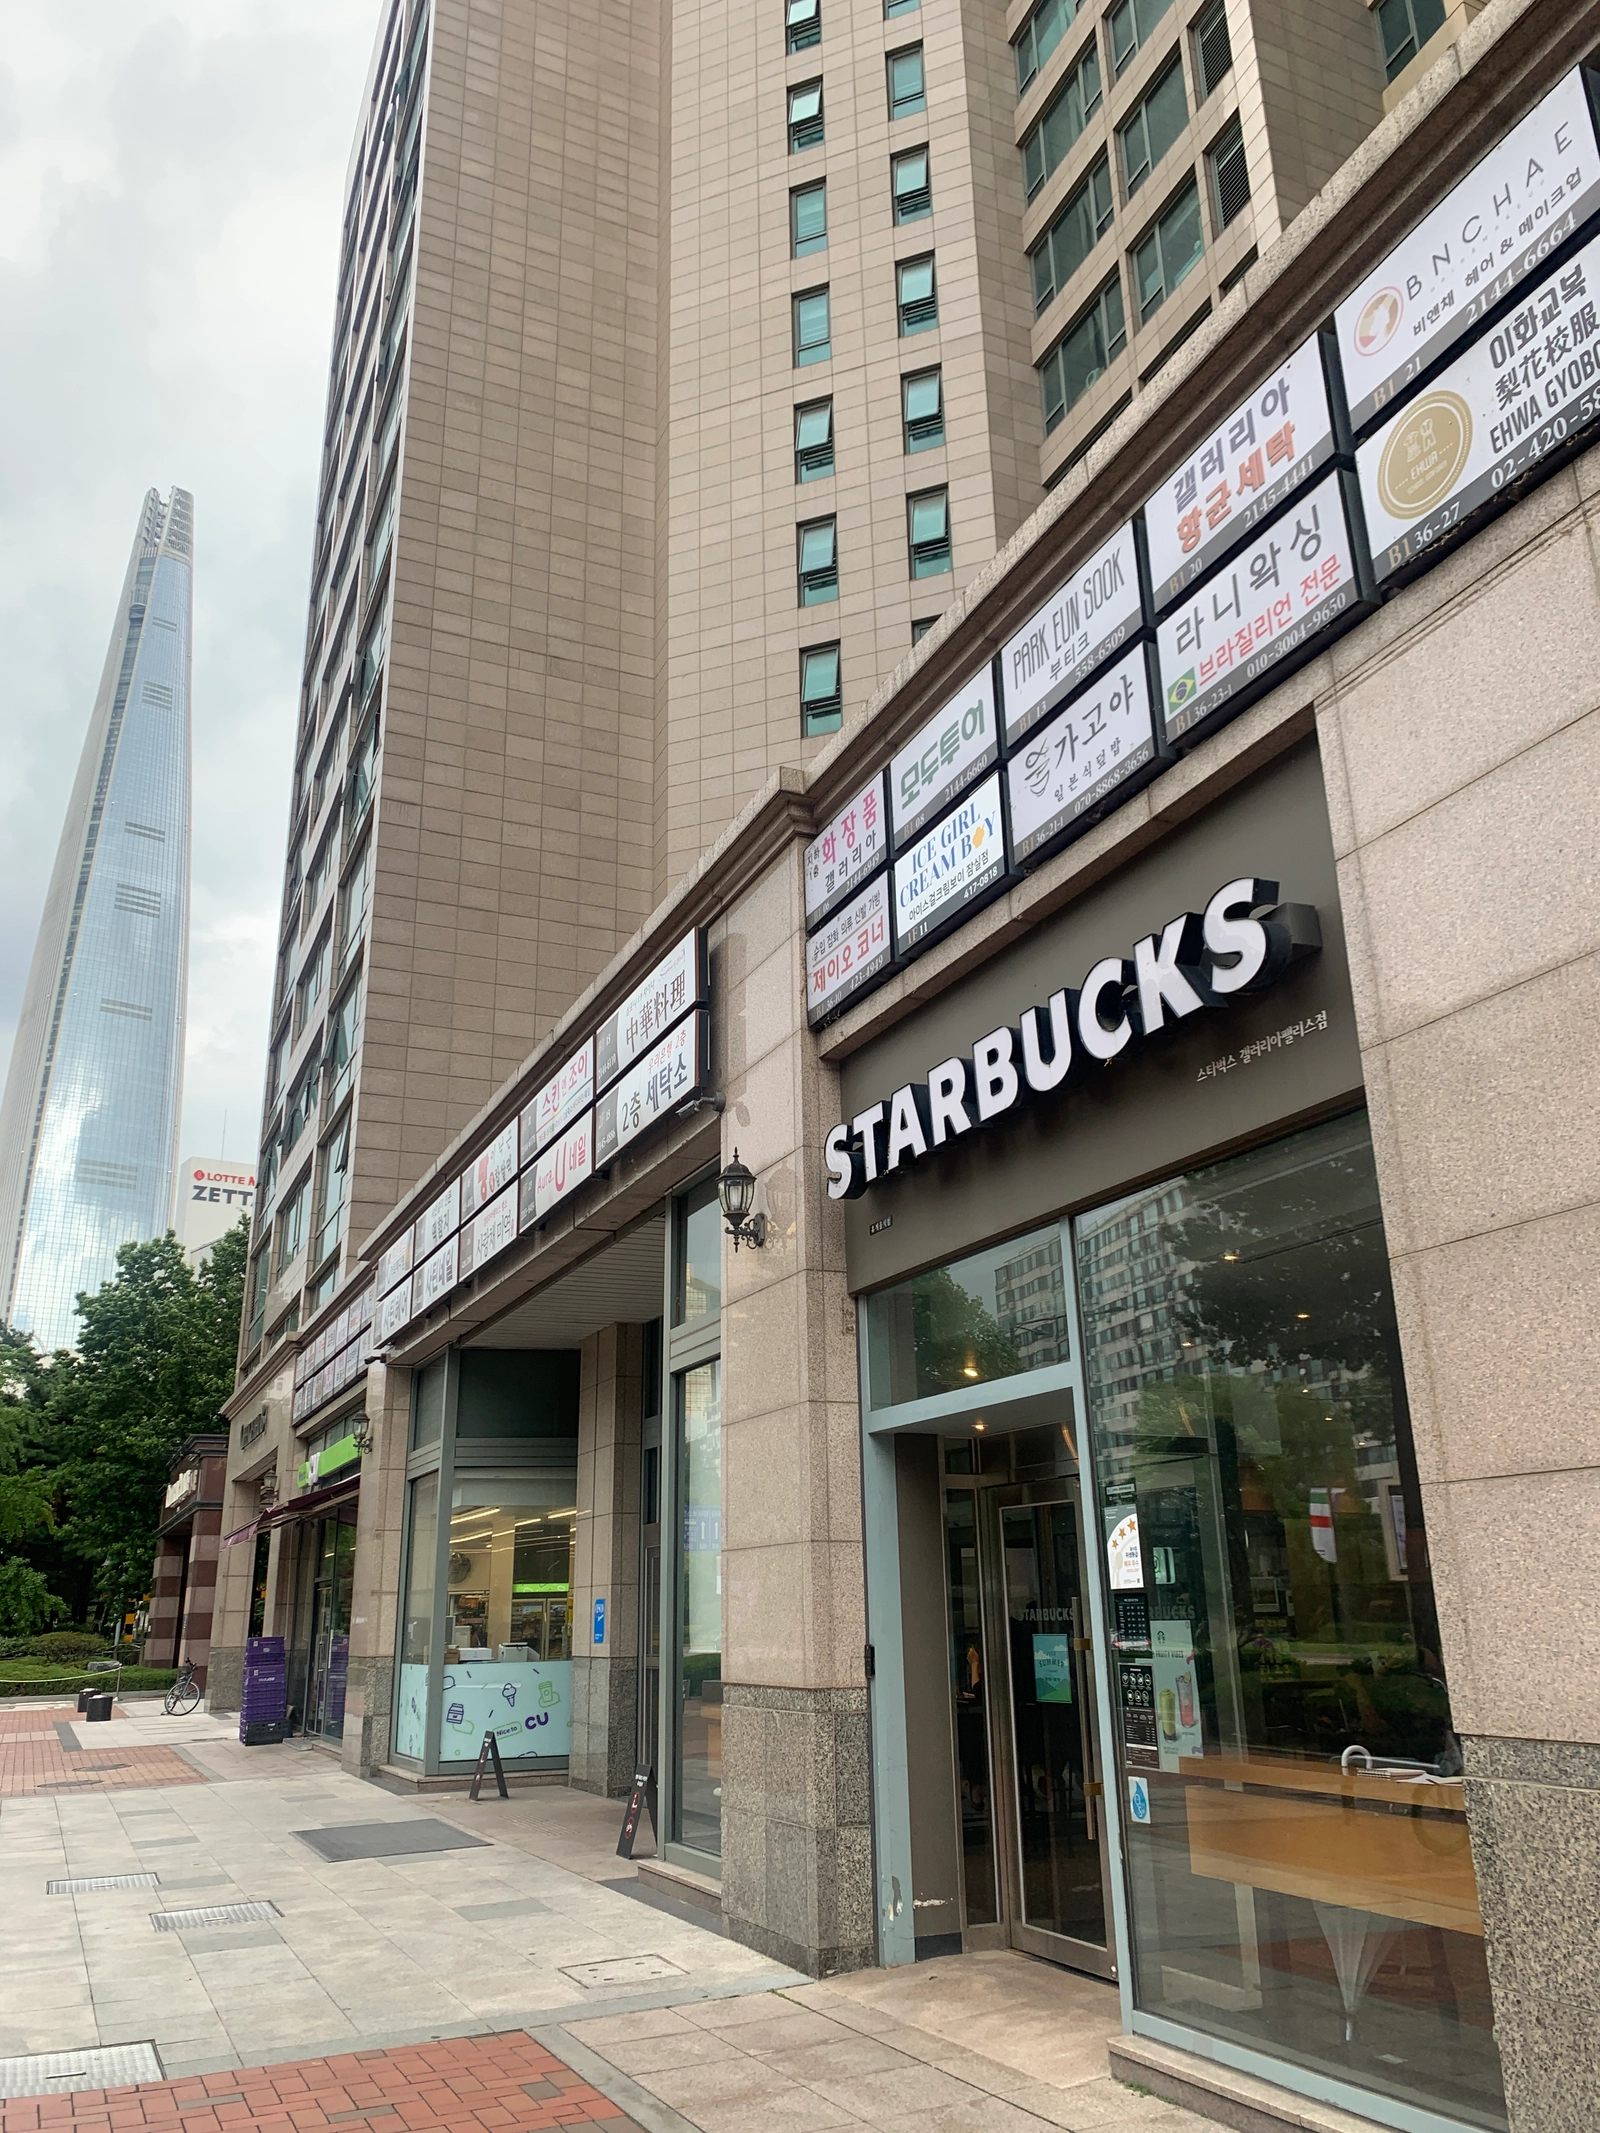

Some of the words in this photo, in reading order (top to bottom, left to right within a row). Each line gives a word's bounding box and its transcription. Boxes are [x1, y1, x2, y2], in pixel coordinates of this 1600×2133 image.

[1413, 290, 1455, 336] 비앤채
[1464, 252, 1495, 287] 헤어
[1500, 238, 1514, 255] &
[1518, 167, 1583, 237] 메이크업
[1373, 383, 1395, 410] B1
[1405, 357, 1422, 382] 21
[1465, 211, 1577, 325] 2144-6664
[1490, 264, 1587, 369] 이화교복
[1495, 300, 1599, 411] 梨花校服
[1173, 378, 1290, 514] 갤러리아
[1490, 394, 1542, 454] EHWA
[1177, 420, 1295, 553] 항균세탁
[1411, 451, 1438, 479] EHWA
[1169, 573, 1186, 596] B1
[1189, 558, 1203, 579] 20
[1243, 456, 1314, 529] 2145-4441
[1387, 538, 1411, 569] B1
[1414, 502, 1461, 550] 36-27
[1013, 623, 1050, 690] PARK
[1052, 591, 1080, 652] EUN
[1083, 547, 1125, 620] SOOK
[1175, 503, 1322, 655] 라니왁싱
[1049, 631, 1090, 681] 부티크
[1199, 593, 1293, 686] 브라질리언
[1301, 554, 1341, 607] 전문
[1018, 713, 1032, 733] B1
[1036, 701, 1047, 719] 13
[1074, 626, 1126, 683] 558-6509
[1176, 711, 1193, 734] B1
[1194, 684, 1232, 721] 36-23-1
[1246, 592, 1346, 678] 010-3004-9650
[900, 698, 985, 810] 모두투어
[1054, 674, 1134, 770] 가고야
[903, 824, 914, 840] B1
[944, 754, 988, 802] 2144-6660
[1022, 836, 1034, 857] B1
[1035, 816, 1064, 846] 36-21-1
[1074, 746, 1149, 814] 070-8868-3656
[1054, 737, 1121, 803] 일본식덮밥
[822, 788, 877, 865] 화장품
[825, 830, 876, 894] 갤러리아
[911, 837, 937, 875] ICE
[941, 802, 981, 848] GIRL
[899, 845, 956, 908] CREAM
[907, 926, 918, 945] 1F
[919, 921, 928, 936] 11
[963, 865, 998, 899] 417-0818
[908, 868, 965, 920] 아이스걸크림보이
[966, 848, 990, 878] 잠실점
[813, 939, 825, 961] 수입
[826, 927, 839, 950] 잡화
[840, 916, 853, 936] 의류
[854, 904, 867, 923] 신발
[868, 890, 881, 910] 가방
[813, 944, 853, 993] 제이오
[857, 914, 884, 961] 코너
[626, 969, 686, 1053] 中華料理
[816, 1001, 824, 1016] B1
[849, 955, 884, 991] 423-4949
[648, 1042, 673, 1074] 우리은행
[675, 1030, 687, 1048] 2층
[824, 877, 1272, 1200] STARBUCKS
[1196, 1054, 1238, 1082] 스타벅스
[622, 1091, 641, 1132] 2층
[646, 1052, 688, 1113] 세탁소
[207, 1173, 245, 1185] LOTTE
[569, 1132, 587, 1171] 네일
[192, 1185, 254, 1207] ZETT
[496, 1727, 511, 1737] Nice
[524, 1711, 549, 1730] CU
